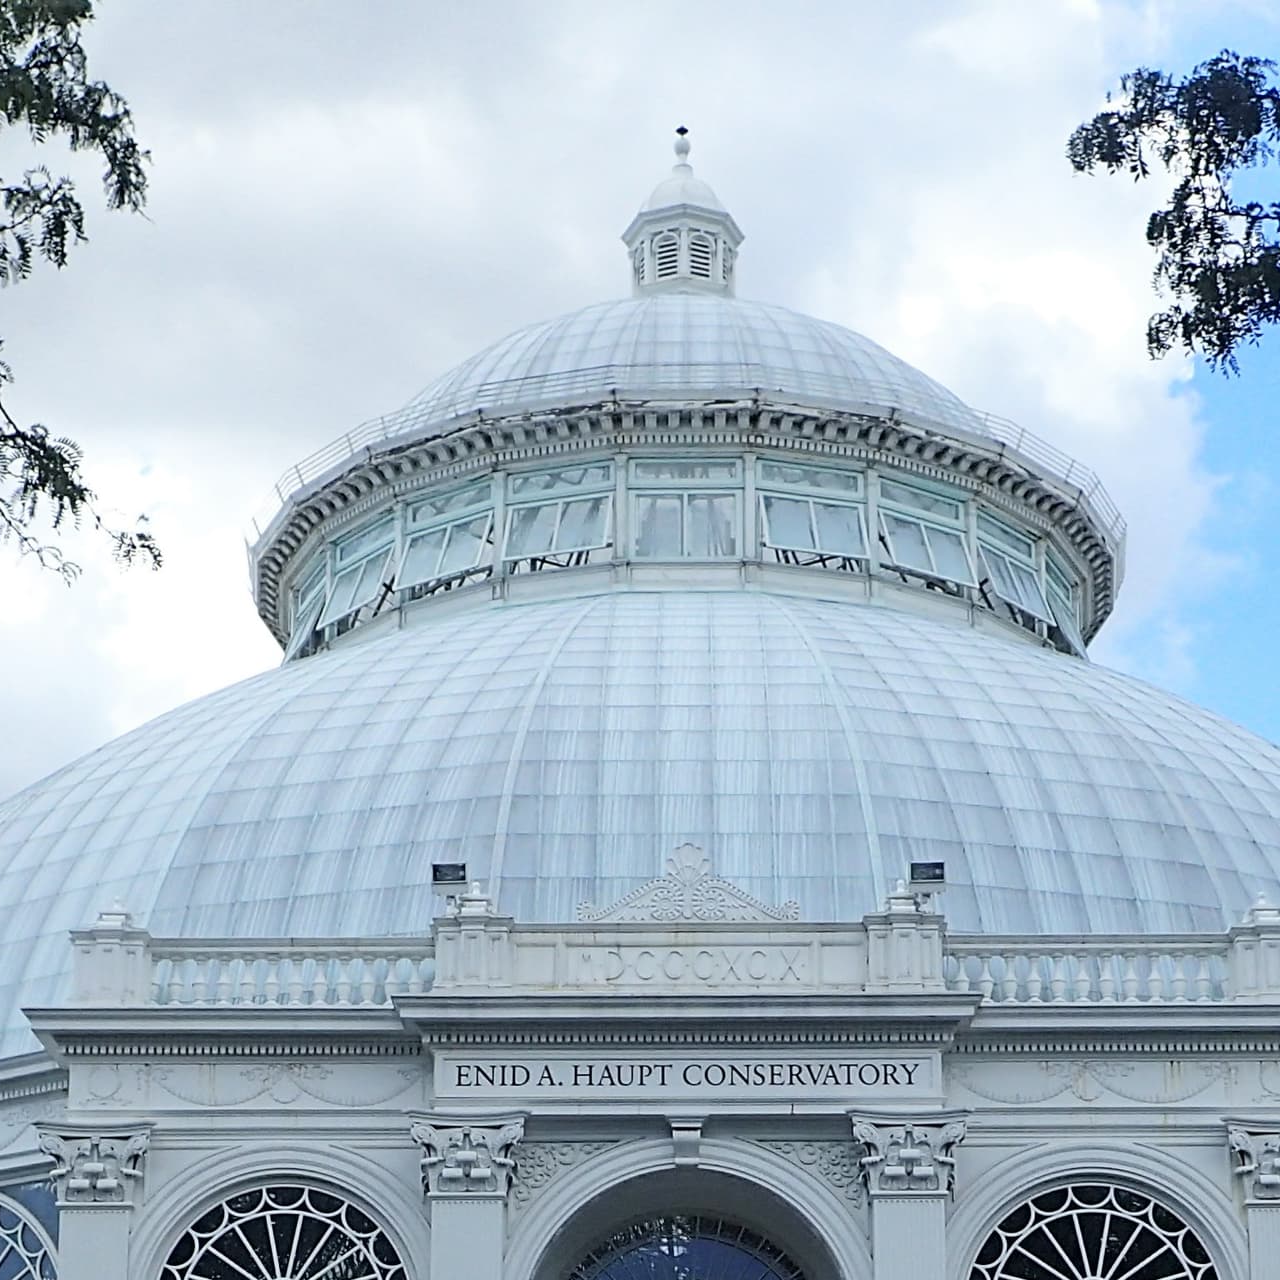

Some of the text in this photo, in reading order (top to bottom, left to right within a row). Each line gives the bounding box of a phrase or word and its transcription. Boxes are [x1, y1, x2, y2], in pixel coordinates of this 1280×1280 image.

[455, 1063, 920, 1087] ENID A. HAUPT CONSERVATORY
